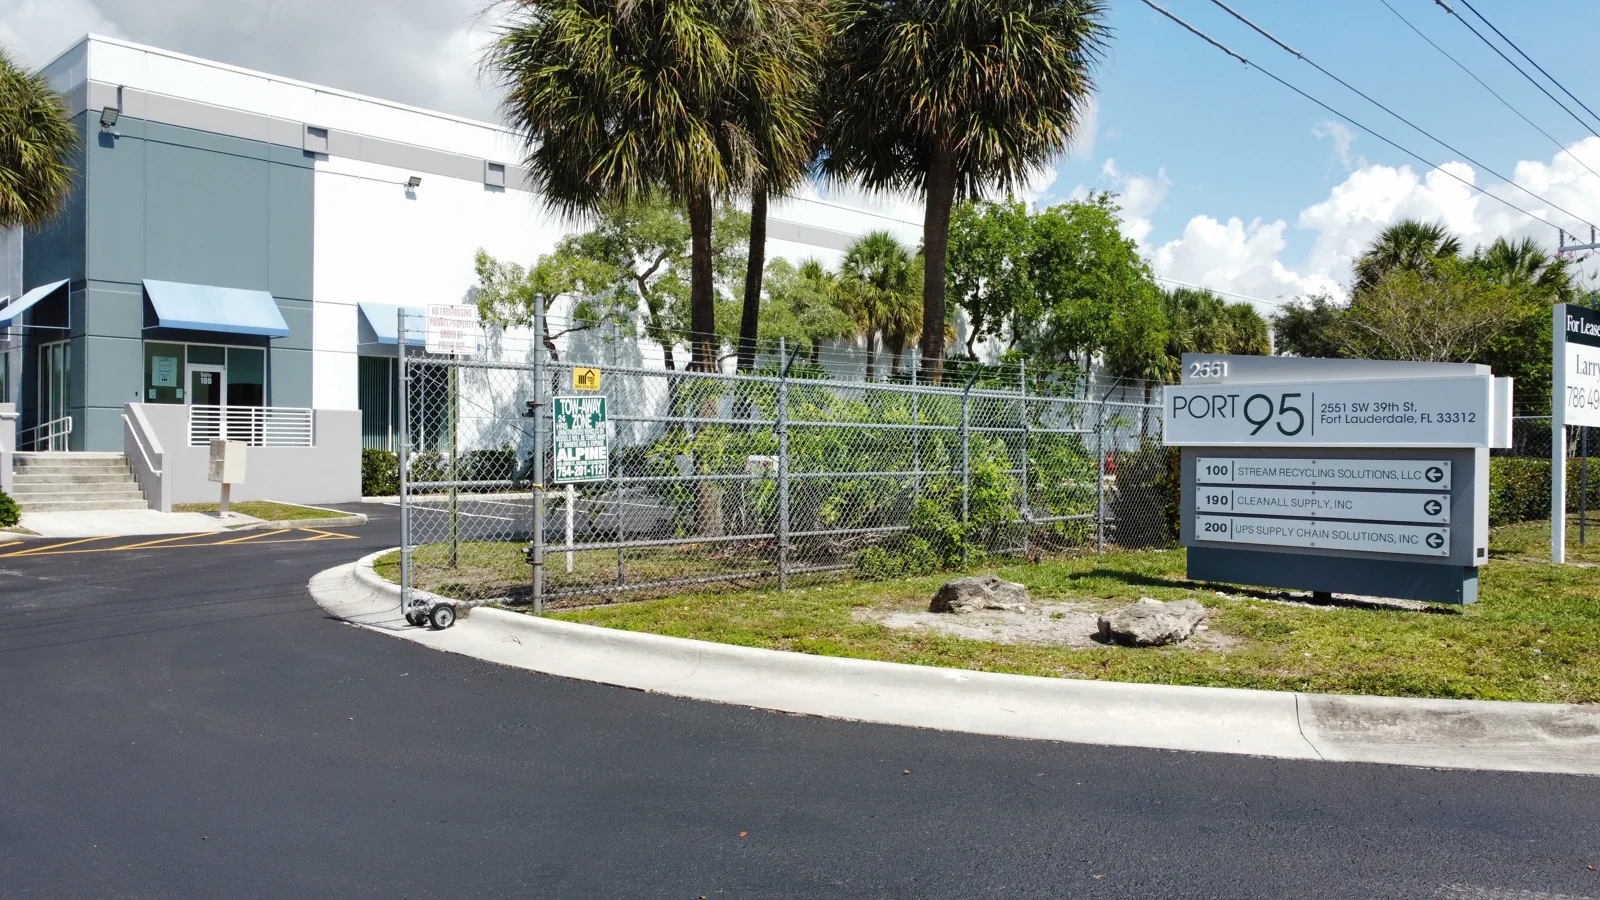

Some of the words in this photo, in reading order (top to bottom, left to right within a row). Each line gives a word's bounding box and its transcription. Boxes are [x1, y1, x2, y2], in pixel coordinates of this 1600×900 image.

[440, 307, 472, 317] TRESPASSING
[1566, 315, 1580, 332] For
[1581, 317, 1600, 337] Lease
[1189, 361, 1228, 379] 2551
[200, 377, 212, 385] 100
[1567, 386, 1585, 408] 786
[560, 398, 602, 415] TOW-AWAY
[1320, 403, 1346, 413] 2551
[1351, 403, 1369, 412] SW
[1373, 402, 1399, 412] 39th
[1403, 402, 1417, 413] St,
[557, 414, 566, 423] 24
[572, 413, 592, 429] ZONE
[598, 413, 602, 421] 7
[1173, 394, 1240, 419] PORT
[1243, 393, 1305, 437] 95
[1320, 414, 1341, 424] Fort
[1345, 413, 1417, 425] Lauderdale,
[1420, 413, 1432, 423] FL
[1436, 412, 1476, 423] 33312
[556, 422, 568, 430] HRS
[557, 446, 606, 461] ALPINE
[557, 464, 606, 477] 754-201-1121
[1206, 465, 1228, 476] 100
[1238, 467, 1277, 477] STREAM
[1279, 467, 1335, 478] RECYCLING
[1337, 469, 1399, 480] SOLUTIONS,
[1401, 470, 1422, 480] LLC
[1206, 495, 1228, 505] 190
[1237, 496, 1288, 507] CLEANALL
[1291, 498, 1332, 509] SUPPLY,
[1334, 500, 1353, 509] INC
[1204, 522, 1227, 533] 200
[1235, 525, 1254, 534] UPS
[1256, 526, 1294, 537] SUPPLY
[1296, 528, 1329, 538] CHAIN
[1331, 530, 1397, 544] SOLUTIONS,
[1399, 534, 1419, 544] INC
